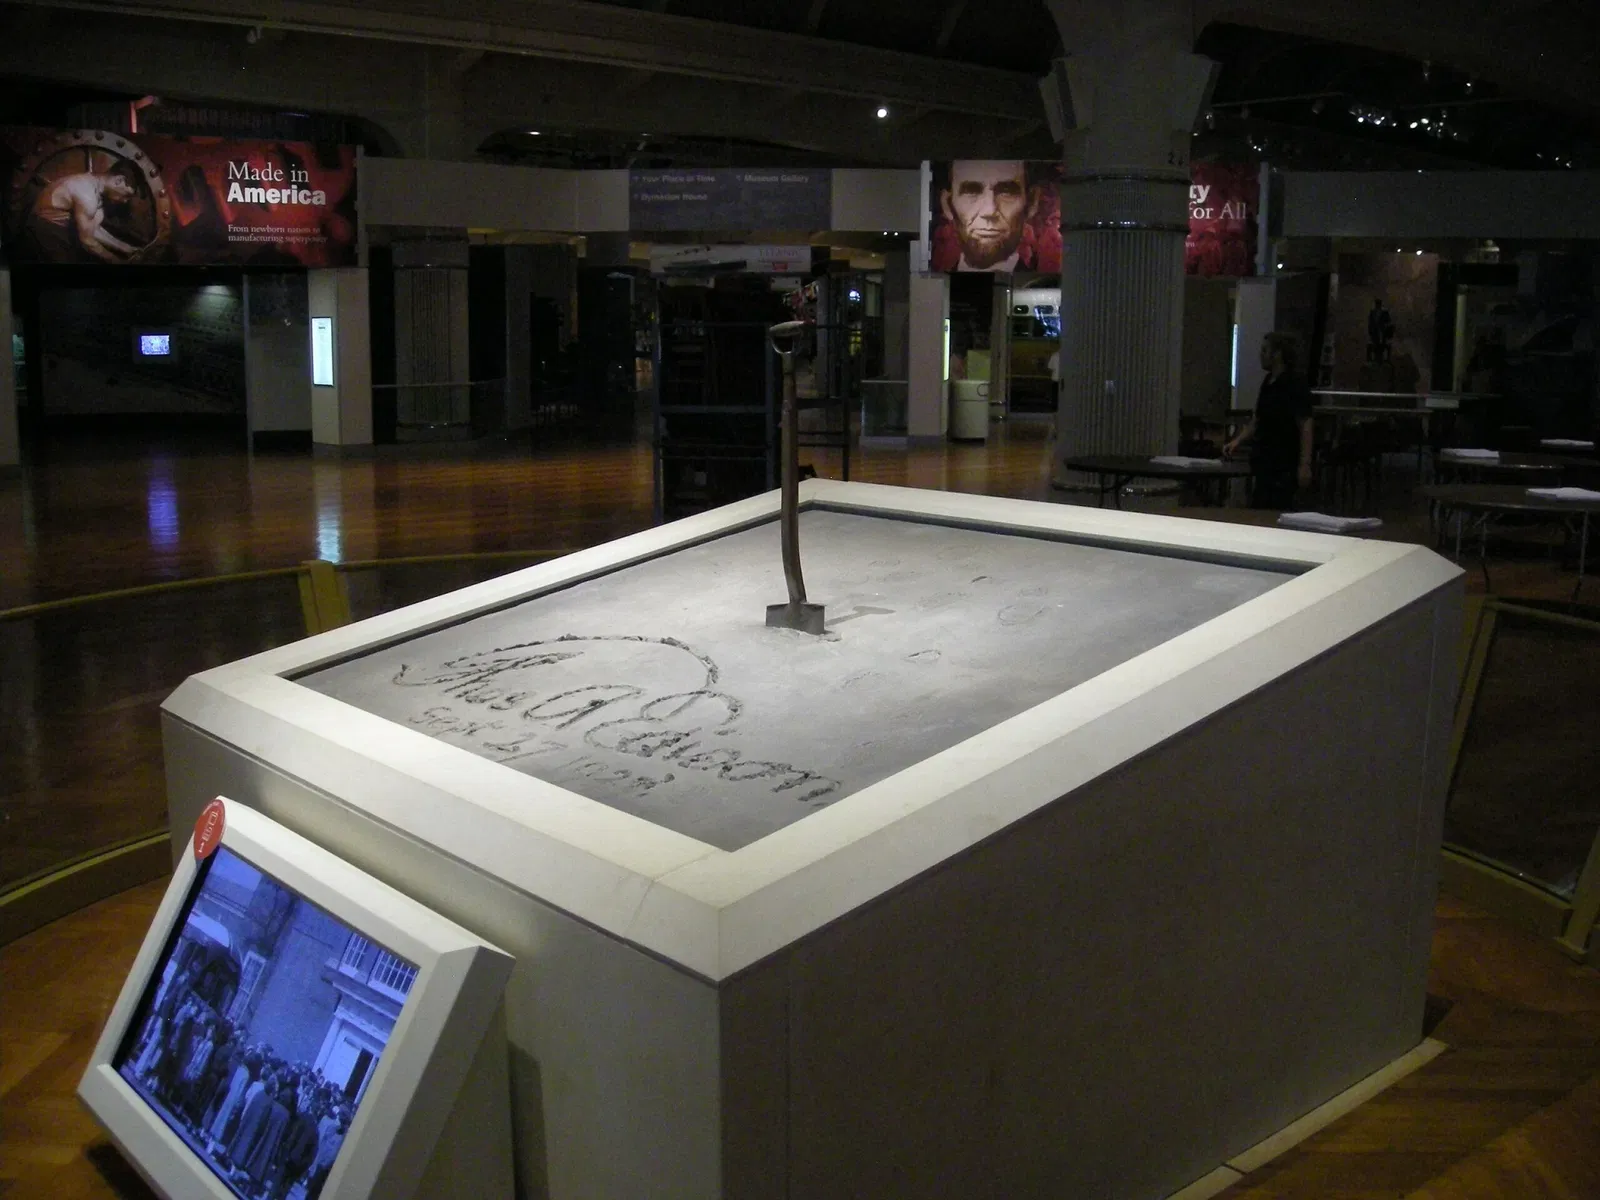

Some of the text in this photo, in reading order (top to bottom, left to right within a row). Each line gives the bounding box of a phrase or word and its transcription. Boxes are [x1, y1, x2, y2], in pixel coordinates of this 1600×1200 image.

[227, 161, 310, 183] Made in
[743, 173, 779, 183] Museum
[227, 182, 326, 206] America
[1218, 200, 1248, 220] All
[228, 224, 249, 233] From
[251, 224, 285, 233] newborn
[228, 233, 284, 244] manufacturing
